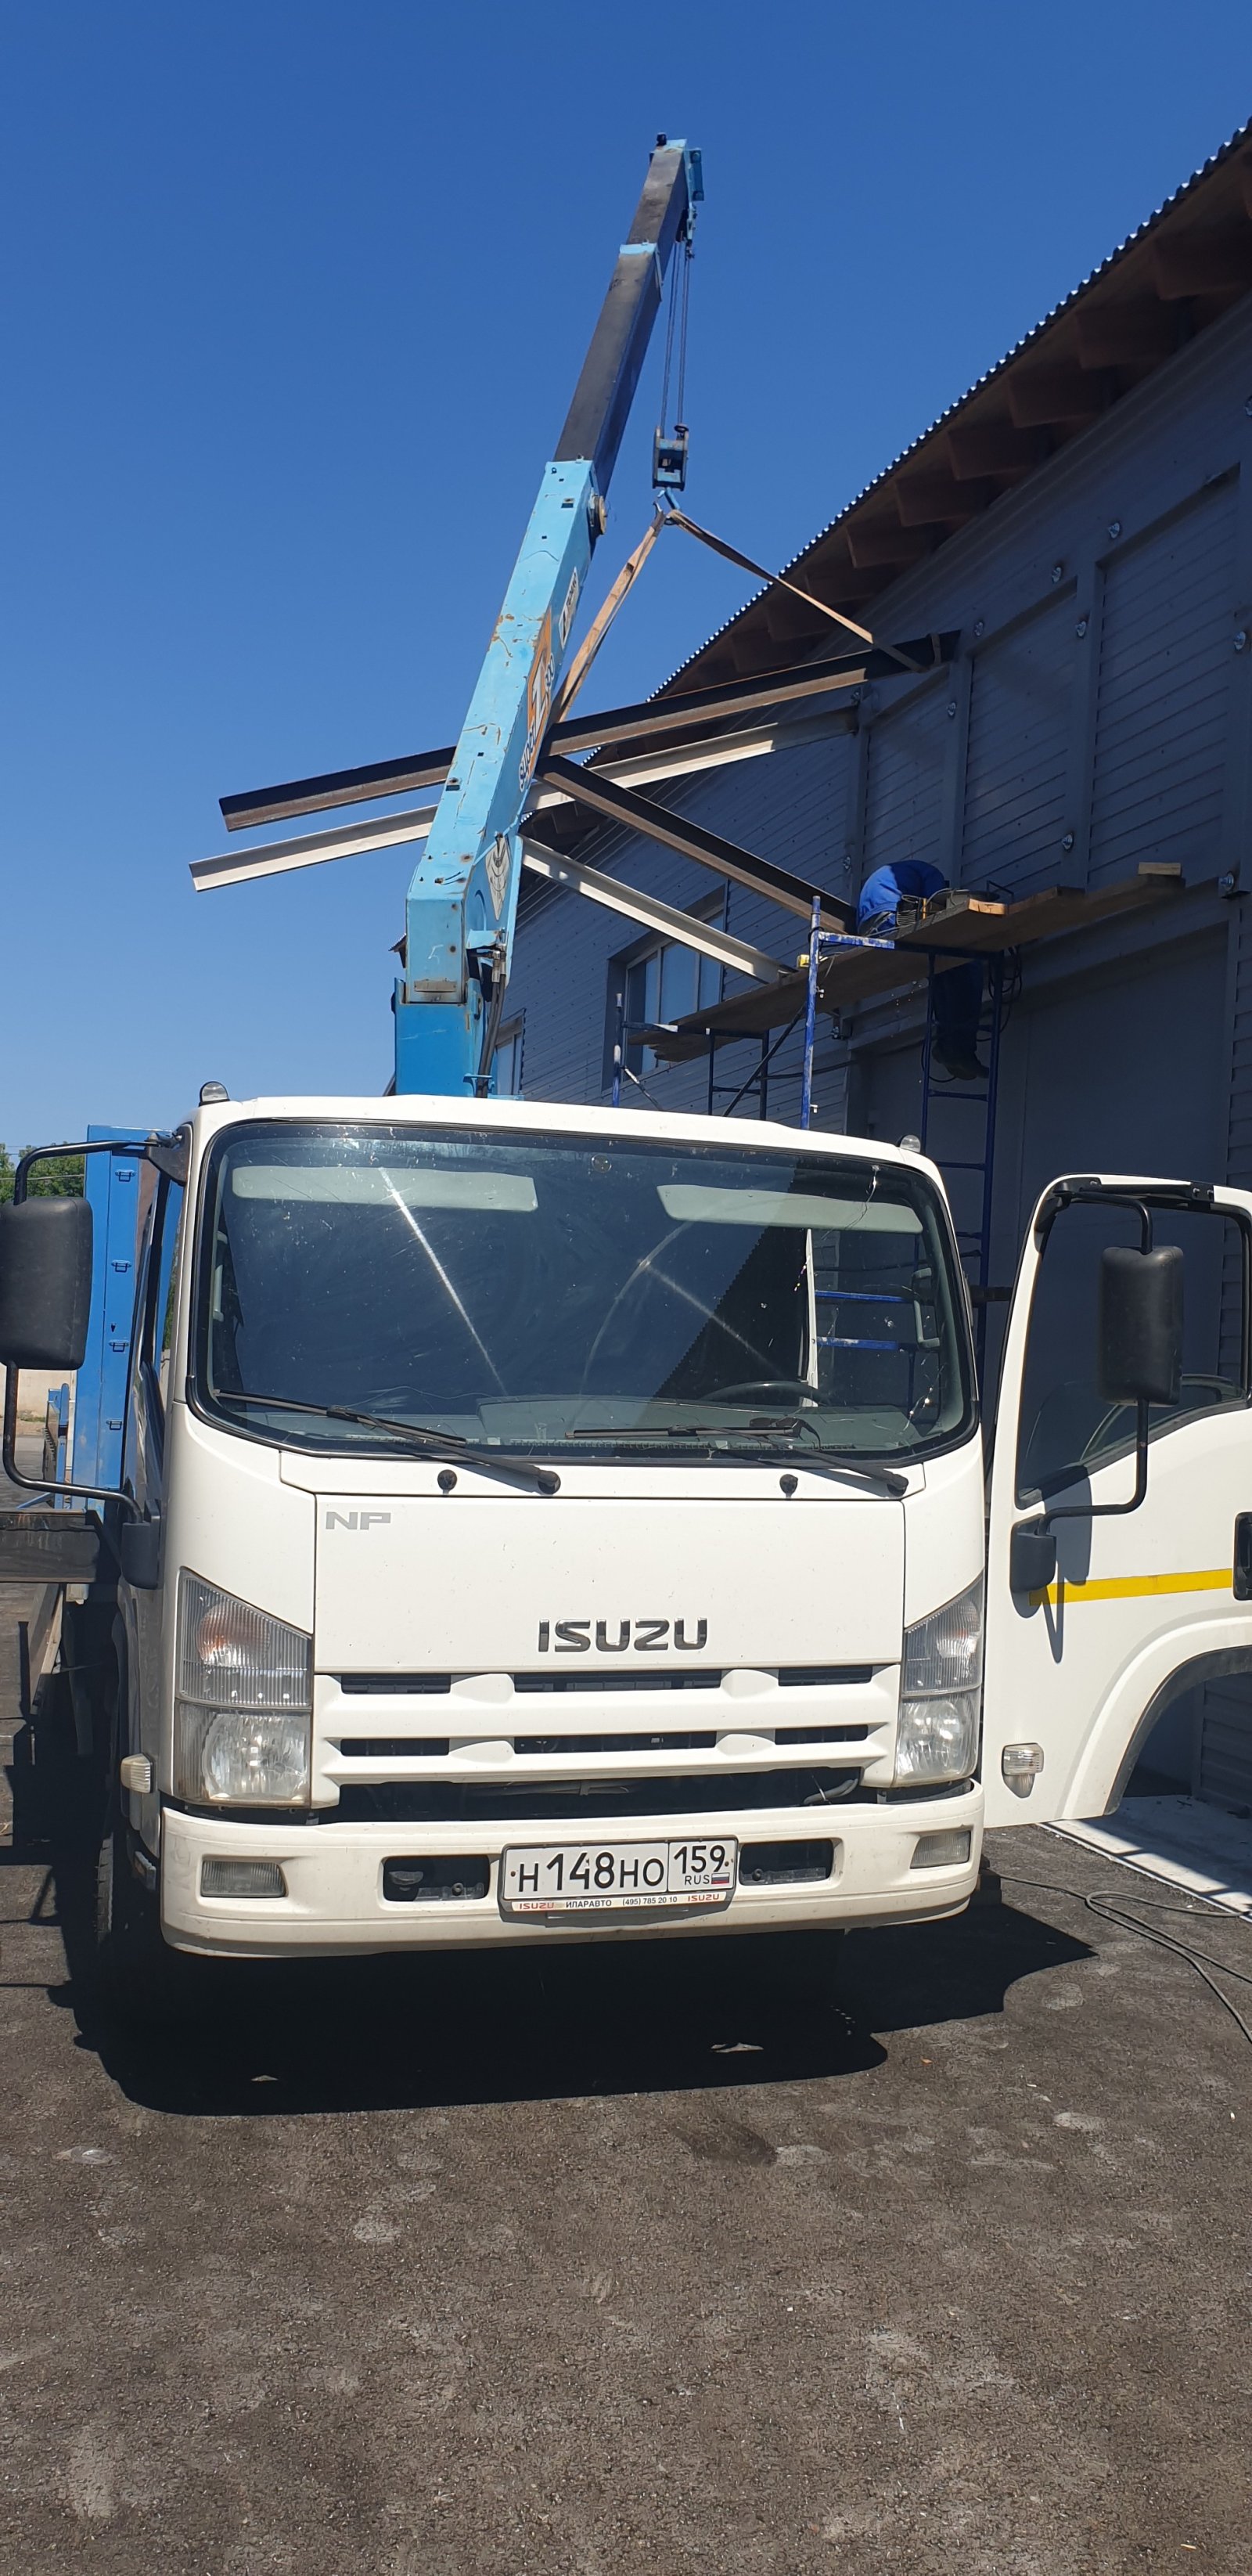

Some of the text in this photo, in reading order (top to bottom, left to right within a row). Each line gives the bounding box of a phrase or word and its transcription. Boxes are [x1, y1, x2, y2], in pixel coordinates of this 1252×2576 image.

[326, 1511, 391, 1529] NP
[538, 1617, 708, 1653] ISUZU
[518, 1844, 726, 1892] Н148НО 159
[684, 1874, 711, 1886] RUS
[687, 1893, 720, 1902] ISUZU
